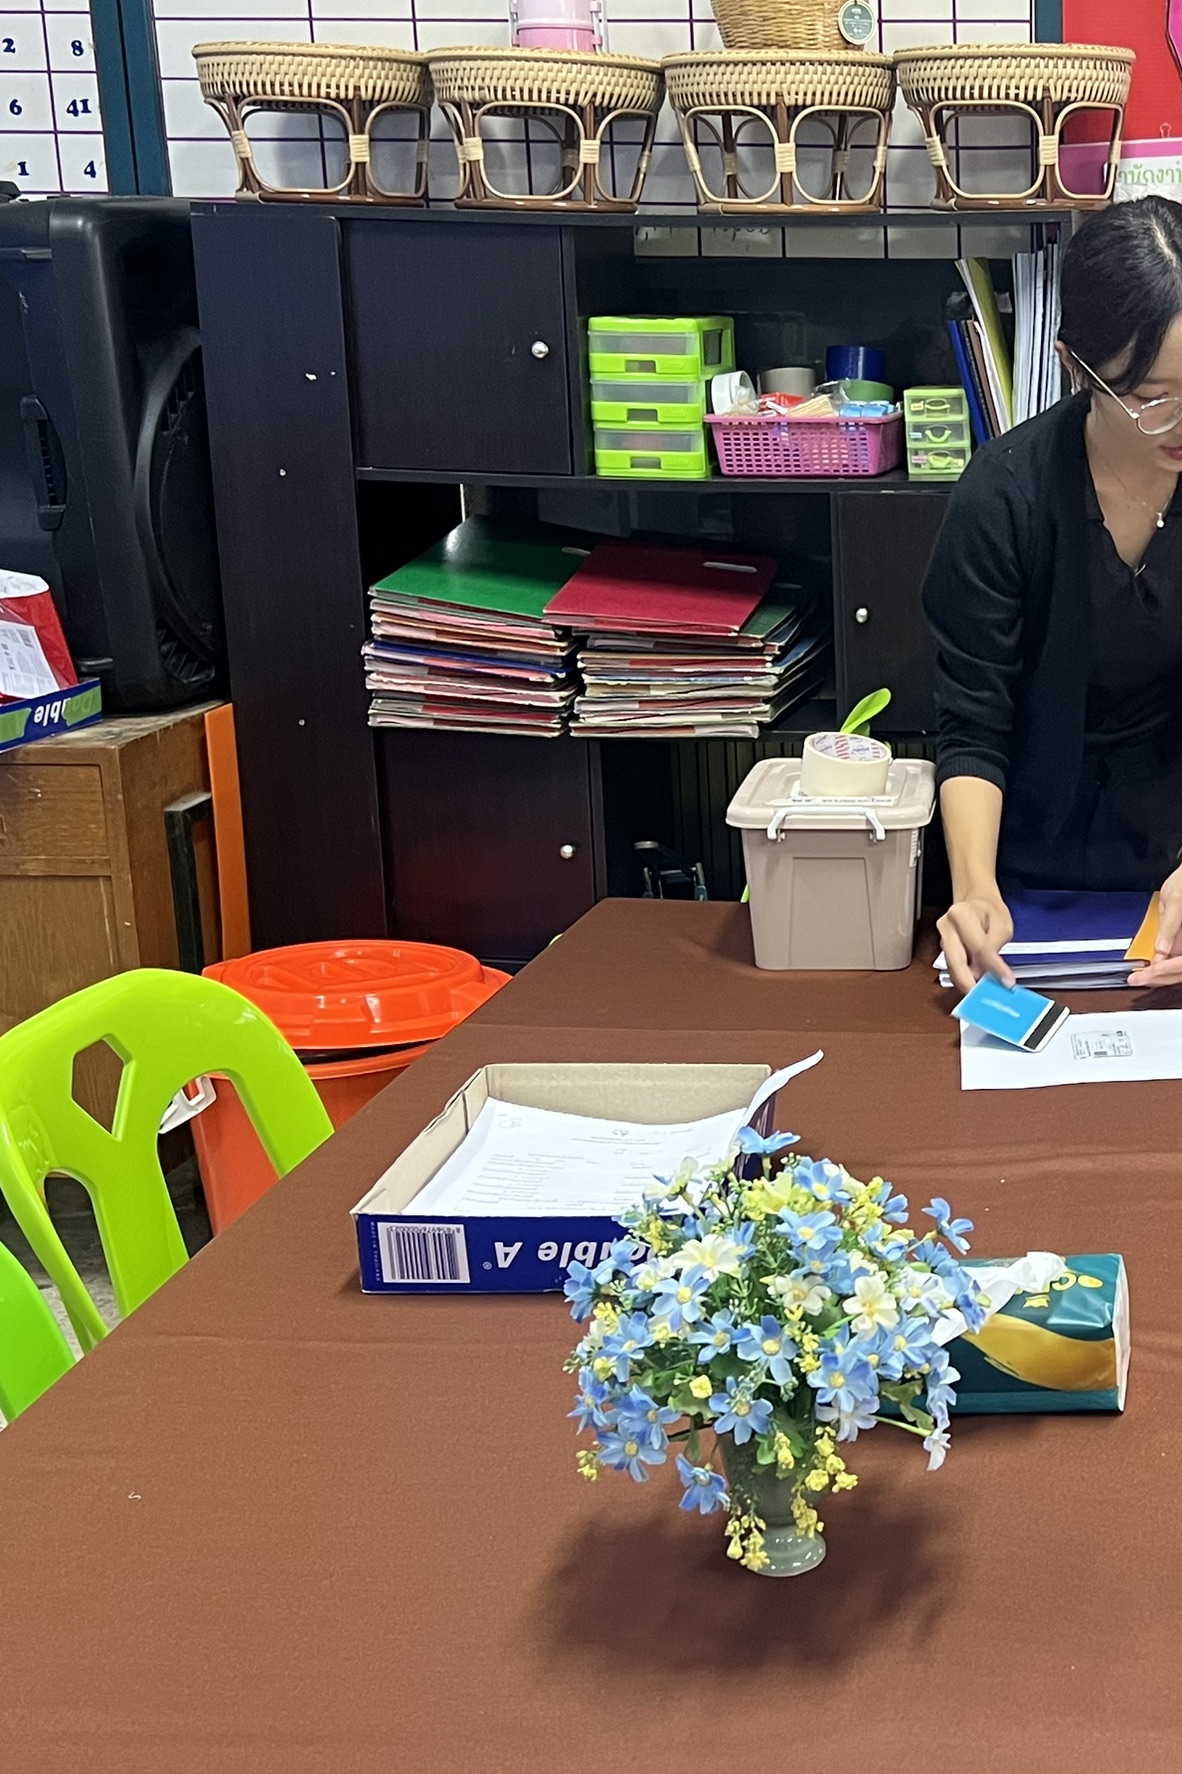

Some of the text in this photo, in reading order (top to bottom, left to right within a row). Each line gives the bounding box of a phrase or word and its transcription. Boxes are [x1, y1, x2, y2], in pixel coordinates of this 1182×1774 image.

[2, 38, 16, 53] 2
[71, 40, 84, 56] 8
[9, 99, 22, 115] 6
[66, 99, 92, 117] 41
[17, 162, 30, 176] 1
[84, 161, 96, 178] 4
[494, 1241, 523, 1269] A
